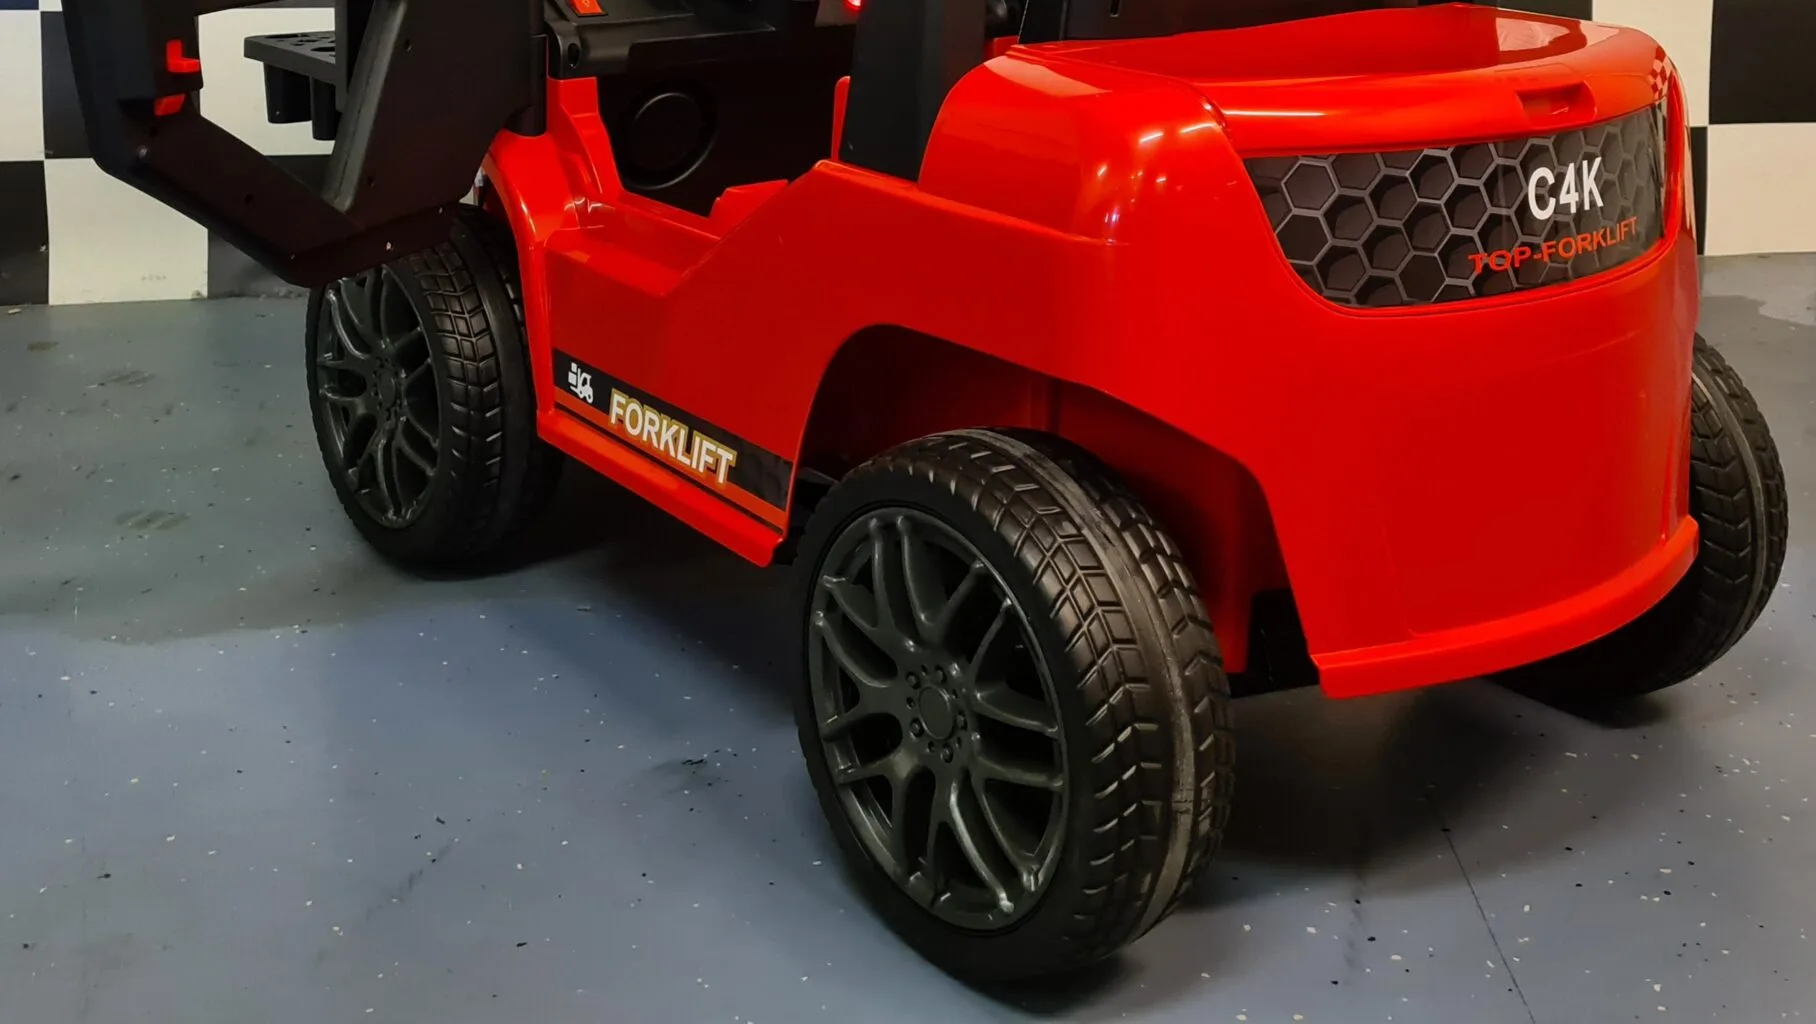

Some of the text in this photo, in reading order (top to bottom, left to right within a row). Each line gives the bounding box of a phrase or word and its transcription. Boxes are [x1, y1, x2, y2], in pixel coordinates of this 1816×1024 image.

[1528, 157, 1604, 220] C4K
[1468, 217, 1638, 274] TOP-FORKLIFT
[610, 389, 737, 485] FORKLIFT
